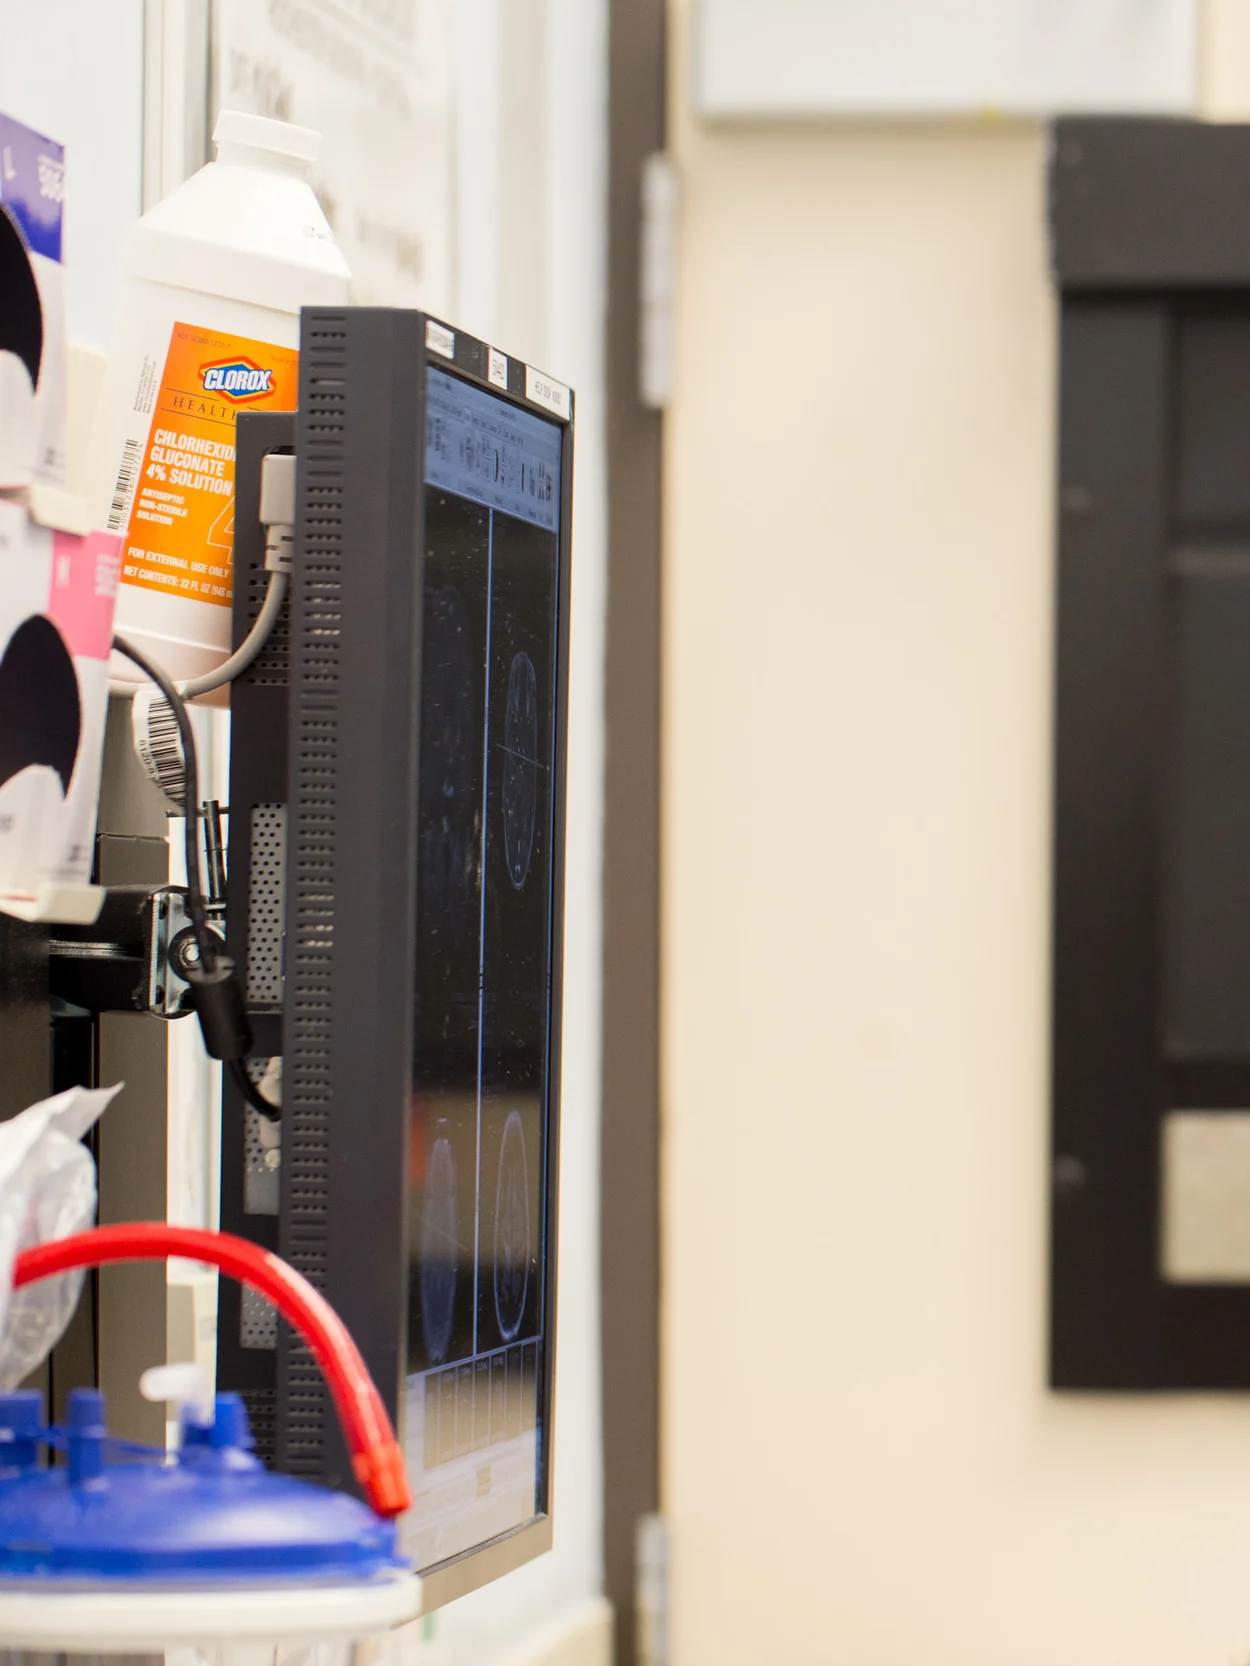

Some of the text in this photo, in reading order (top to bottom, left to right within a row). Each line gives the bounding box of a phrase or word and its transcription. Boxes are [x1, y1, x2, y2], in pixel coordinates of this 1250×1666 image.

[203, 368, 272, 391] CLOROX
[154, 428, 235, 462] CHLORHEXID
[150, 445, 226, 477] GLUCONATE
[146, 463, 233, 496] 4% SOLUTION
[139, 498, 188, 518] NON-STERILE
[141, 487, 185, 504] ANTISEPTIC
[136, 509, 173, 526] SOLUTION
[128, 546, 230, 578] FOR EXTERNAL USE ONLY
[123, 564, 139, 577] NET
[138, 568, 179, 587] CONTENTS:
[179, 578, 191, 588] 32
[190, 580, 200, 592] FL
[200, 583, 211, 594] OZ
